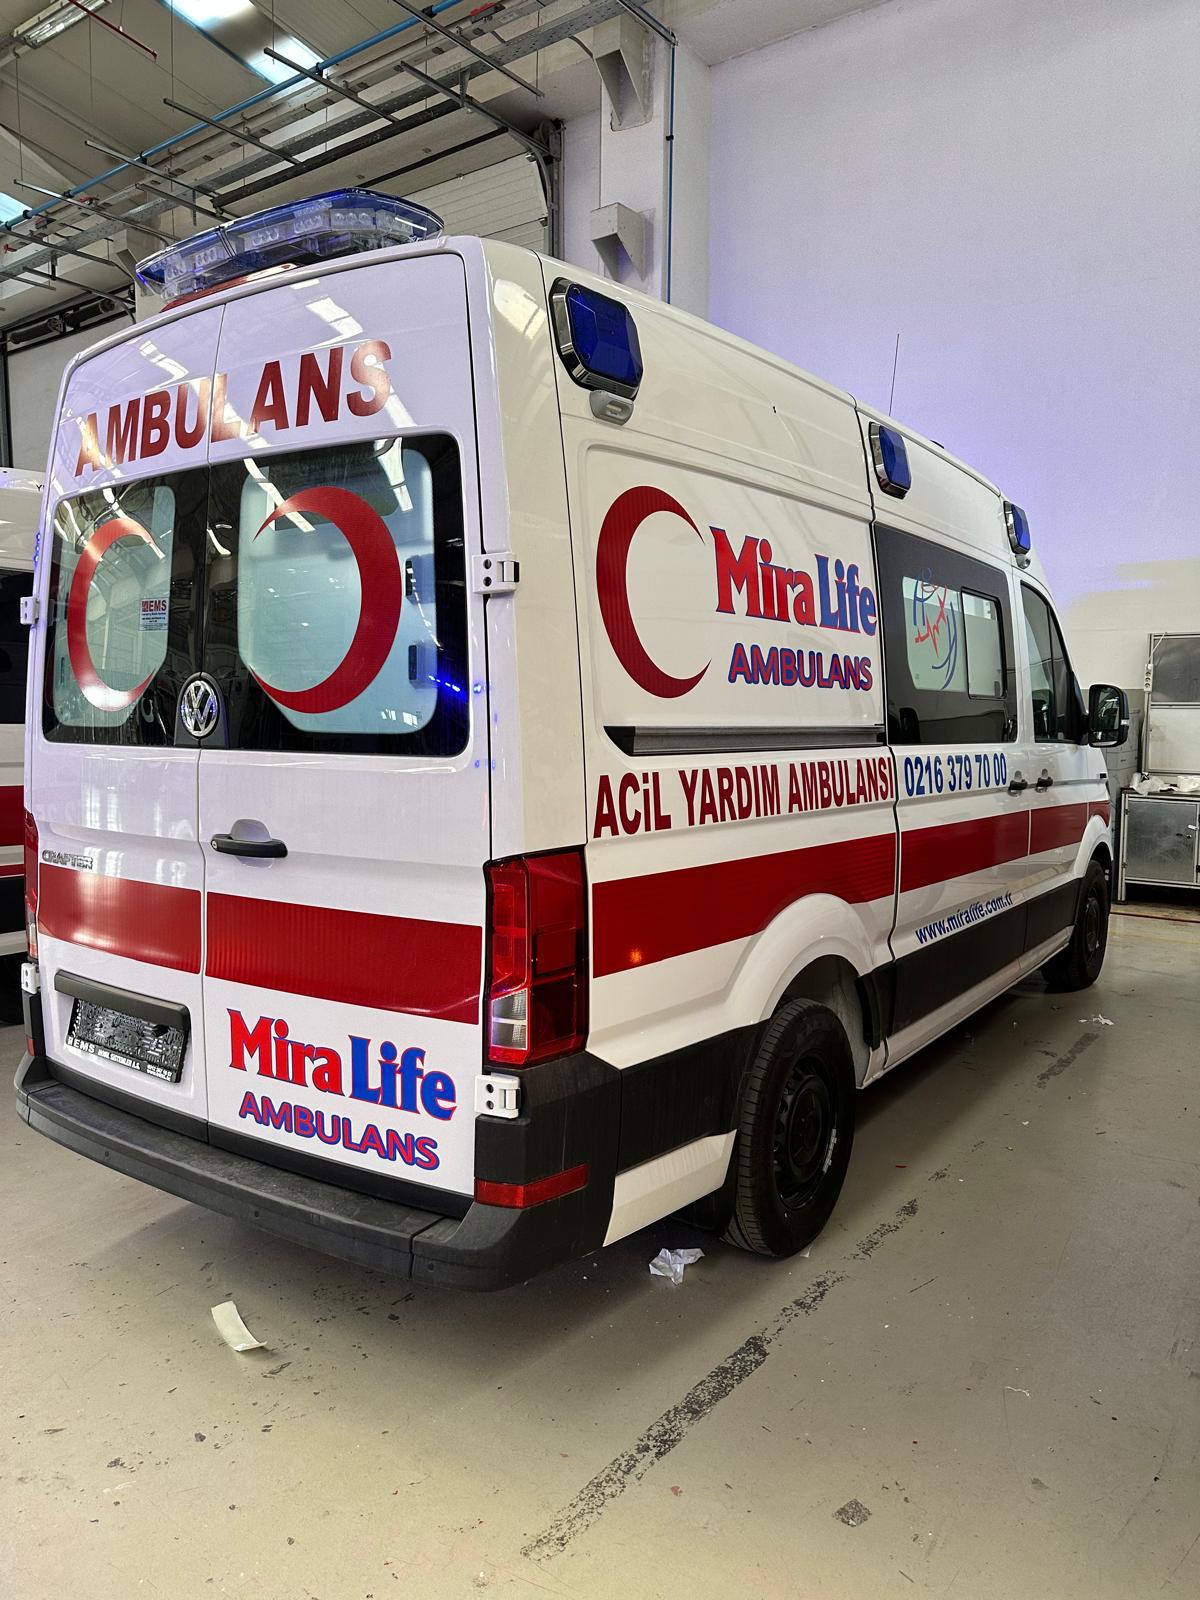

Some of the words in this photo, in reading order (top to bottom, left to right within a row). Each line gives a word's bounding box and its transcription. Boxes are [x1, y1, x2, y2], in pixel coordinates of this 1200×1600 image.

[75, 340, 392, 477] AMBULANS
[728, 643, 873, 691] AMBULANS
[678, 763, 781, 827] YARDIM
[788, 756, 894, 814] AMBULANSI
[904, 755, 944, 797] 0216
[947, 754, 973, 792] 379
[975, 753, 990, 788] 70
[993, 752, 1007, 786] 00
[915, 890, 1013, 944] www.miralife.com.tr
[239, 1091, 440, 1171] AMBULANS
